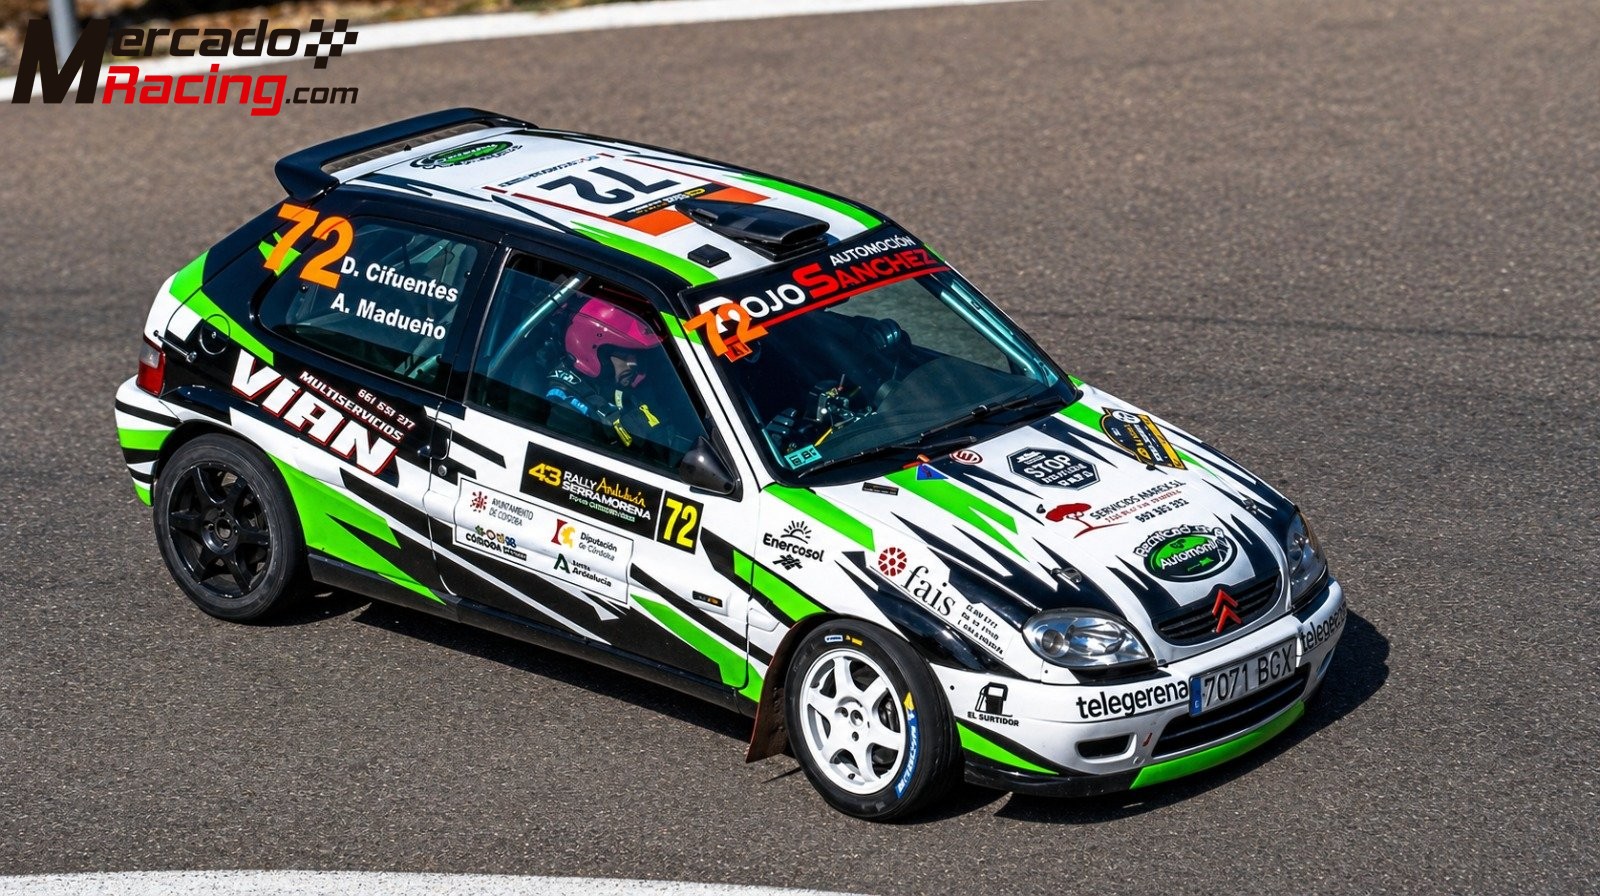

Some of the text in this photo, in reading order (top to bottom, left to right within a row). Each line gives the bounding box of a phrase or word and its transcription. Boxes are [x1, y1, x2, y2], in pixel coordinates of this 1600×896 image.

[536, 166, 682, 205] 72
[263, 203, 354, 290] 72
[828, 234, 916, 268] AUTOMOCIÓN
[340, 256, 459, 303] D. Cifuentes
[792, 249, 937, 298] SANCHEZ
[330, 293, 446, 341] A. Madueño
[683, 301, 769, 357] 72
[231, 348, 399, 477] VIAN
[299, 370, 405, 443] MULTISERVICIOS
[357, 388, 377, 405] 661
[528, 462, 562, 487] 43
[563, 470, 598, 491] RALLY
[1023, 454, 1072, 478] STOP
[662, 497, 697, 549] 72
[1089, 495, 1141, 520] SERVICIOS
[762, 532, 825, 563] Enercosol
[900, 564, 956, 618] fais
[1076, 678, 1189, 720] telegerena
[1203, 663, 1249, 707] 7071
[1257, 644, 1297, 686] BGX
[967, 710, 1020, 727] EL SURTIDOR
